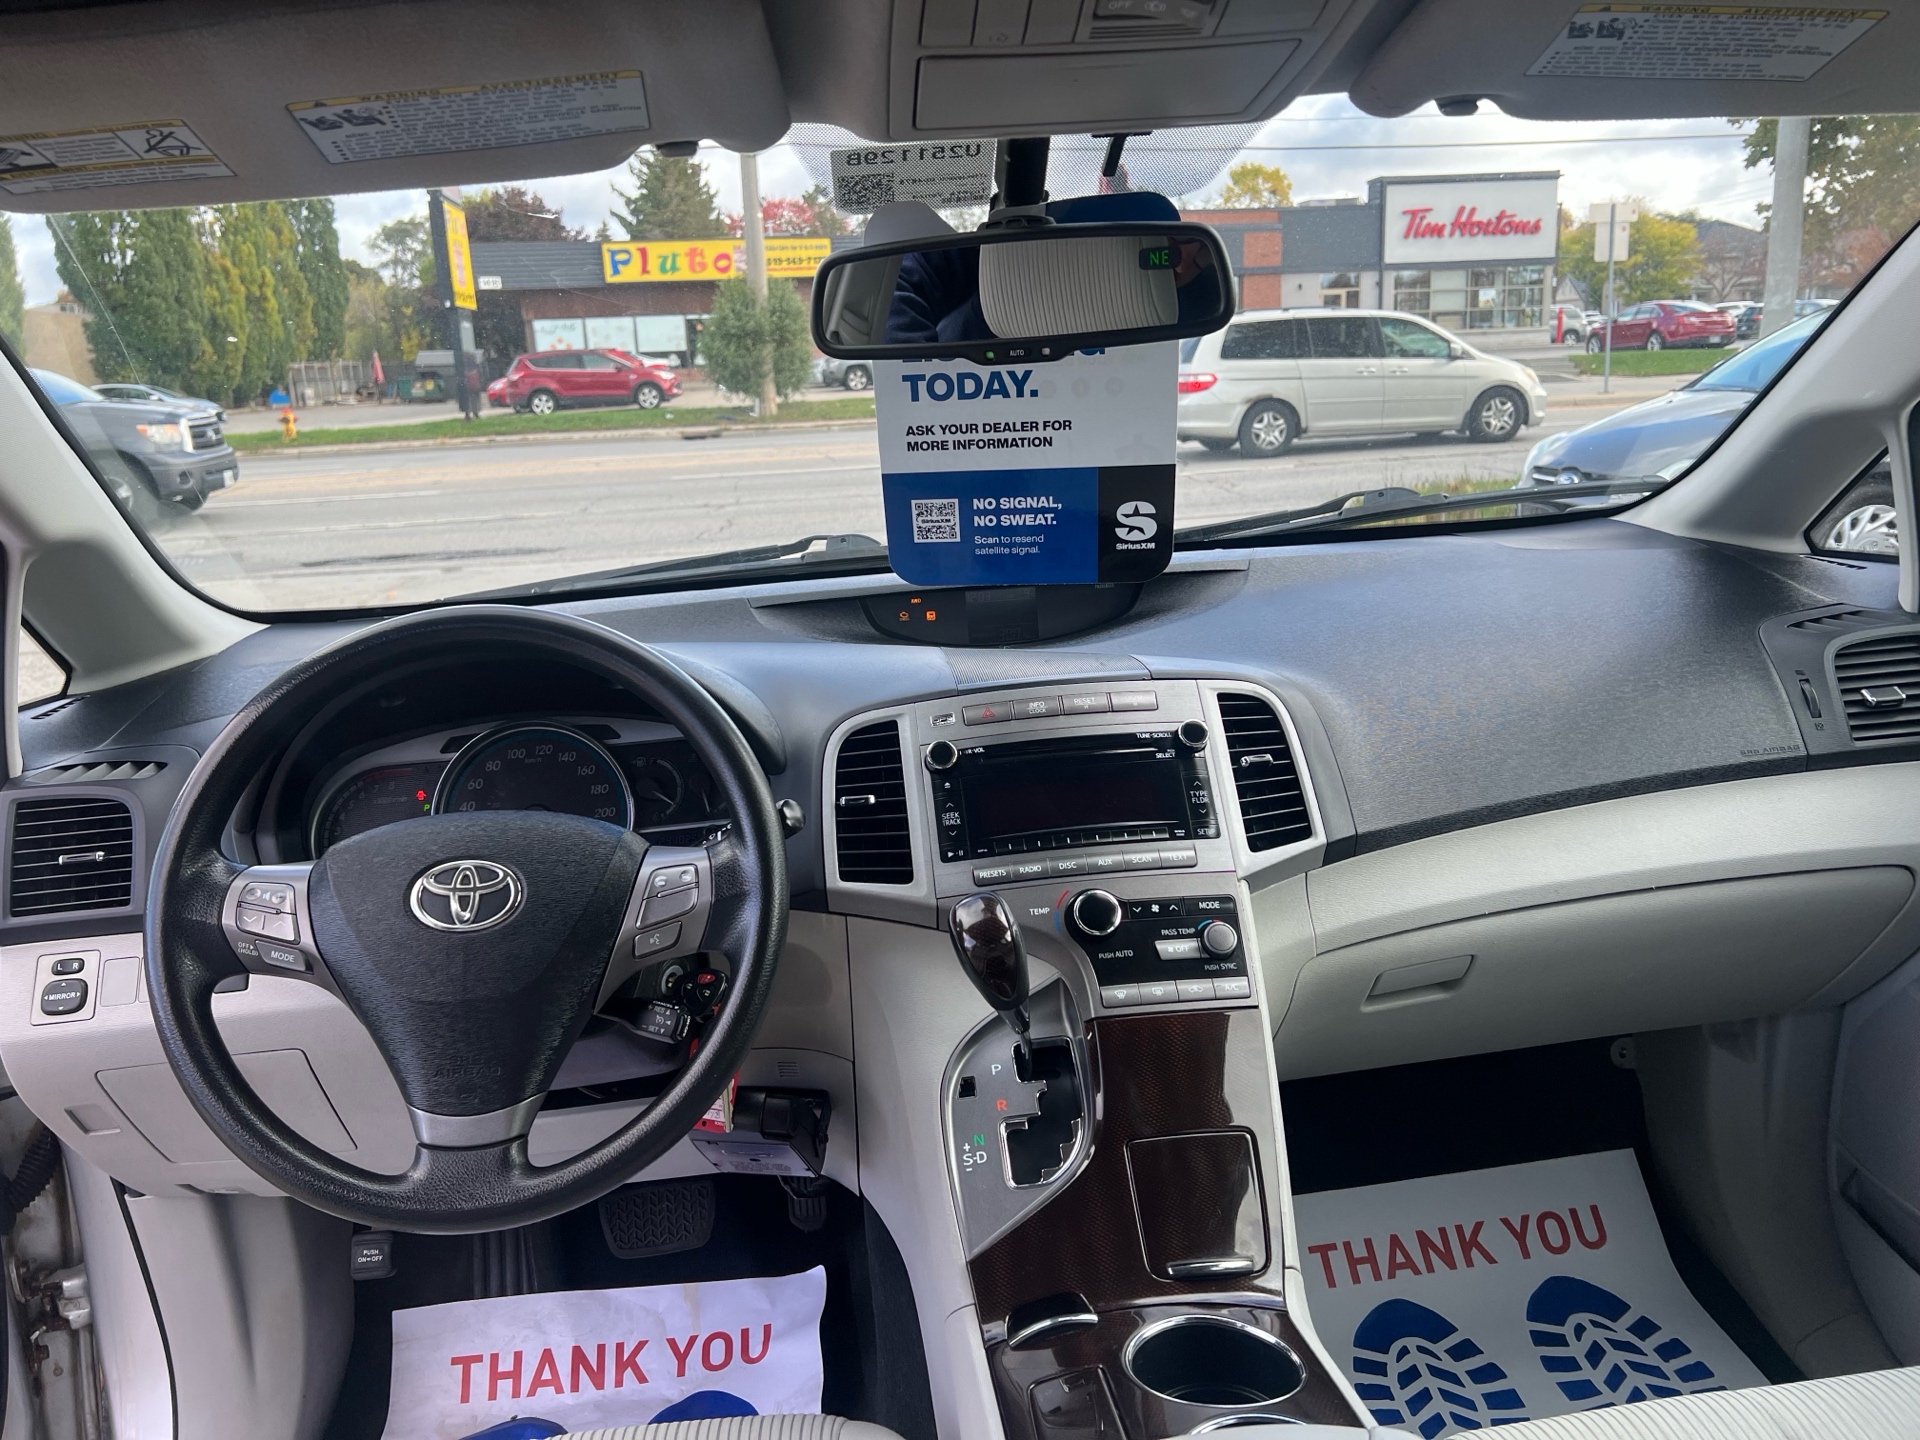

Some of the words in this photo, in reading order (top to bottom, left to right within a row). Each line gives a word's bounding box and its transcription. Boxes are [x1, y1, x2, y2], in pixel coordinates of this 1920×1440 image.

[1641, 5, 1710, 13] WARNING
[1743, 7, 1865, 19] AVERTISSEMENT
[360, 90, 440, 103] WARNING
[480, 71, 619, 90] AVERTISSEMENT
[1402, 207, 1446, 240] Tim
[1449, 204, 1543, 237] Hortons
[1149, 251, 1169, 265] NE
[1009, 349, 1025, 357] AUTO
[902, 369, 1039, 402] TODAY.
[906, 425, 936, 437] ASK
[939, 423, 979, 435] YOUR
[982, 420, 1039, 434] DEALER
[1043, 419, 1072, 432] FOR
[906, 440, 950, 452] MORE
[952, 436, 1053, 451] INFORMATION
[972, 498, 997, 510] NO
[999, 496, 1062, 511] SIGNAL,
[973, 515, 997, 527] NO
[1000, 513, 1057, 526] SWEAT.
[974, 535, 999, 544] Scan
[1001, 535, 1010, 543] to
[1012, 534, 1044, 543] resend
[975, 545, 1010, 555] satellite
[1011, 544, 1040, 555] signal.
[1116, 542, 1156, 550] SiriusXM
[507, 748, 526, 760] 100
[535, 745, 553, 755] 120
[558, 751, 577, 762] 140
[485, 760, 502, 772] 80
[577, 765, 596, 776] 160
[467, 778, 484, 790] 60
[591, 783, 610, 795] 180
[423, 804, 431, 812] P
[459, 800, 475, 812] 40
[594, 806, 616, 818] 200
[941, 811, 960, 820] SEEK
[1059, 861, 1077, 870] DISC
[1098, 858, 1112, 866] AUX
[1131, 856, 1152, 864] SCAN
[980, 869, 1006, 878] PRESETS
[1019, 865, 1042, 873] RADIO
[1199, 901, 1220, 910] MODE
[1029, 907, 1050, 916] TEMP
[1178, 928, 1196, 936] TEMP
[238, 942, 250, 950] OFF
[1175, 945, 1190, 953] OFF
[270, 951, 295, 963] MODE
[1115, 950, 1133, 958] AUTO
[57, 963, 63, 971] L
[73, 962, 79, 970] R
[1220, 962, 1237, 970] SYNC
[1225, 982, 1240, 991] A/C
[49, 992, 76, 1000] MIRROR
[654, 1005, 666, 1013] RES
[648, 1025, 659, 1033] SET
[991, 1064, 1001, 1075] P
[996, 1099, 1007, 1111] R
[973, 1134, 985, 1146] N
[1308, 1220, 1498, 1289] THANK
[1499, 1204, 1607, 1260] YOU
[450, 1339, 650, 1404] THANK
[666, 1323, 772, 1378] YOU
